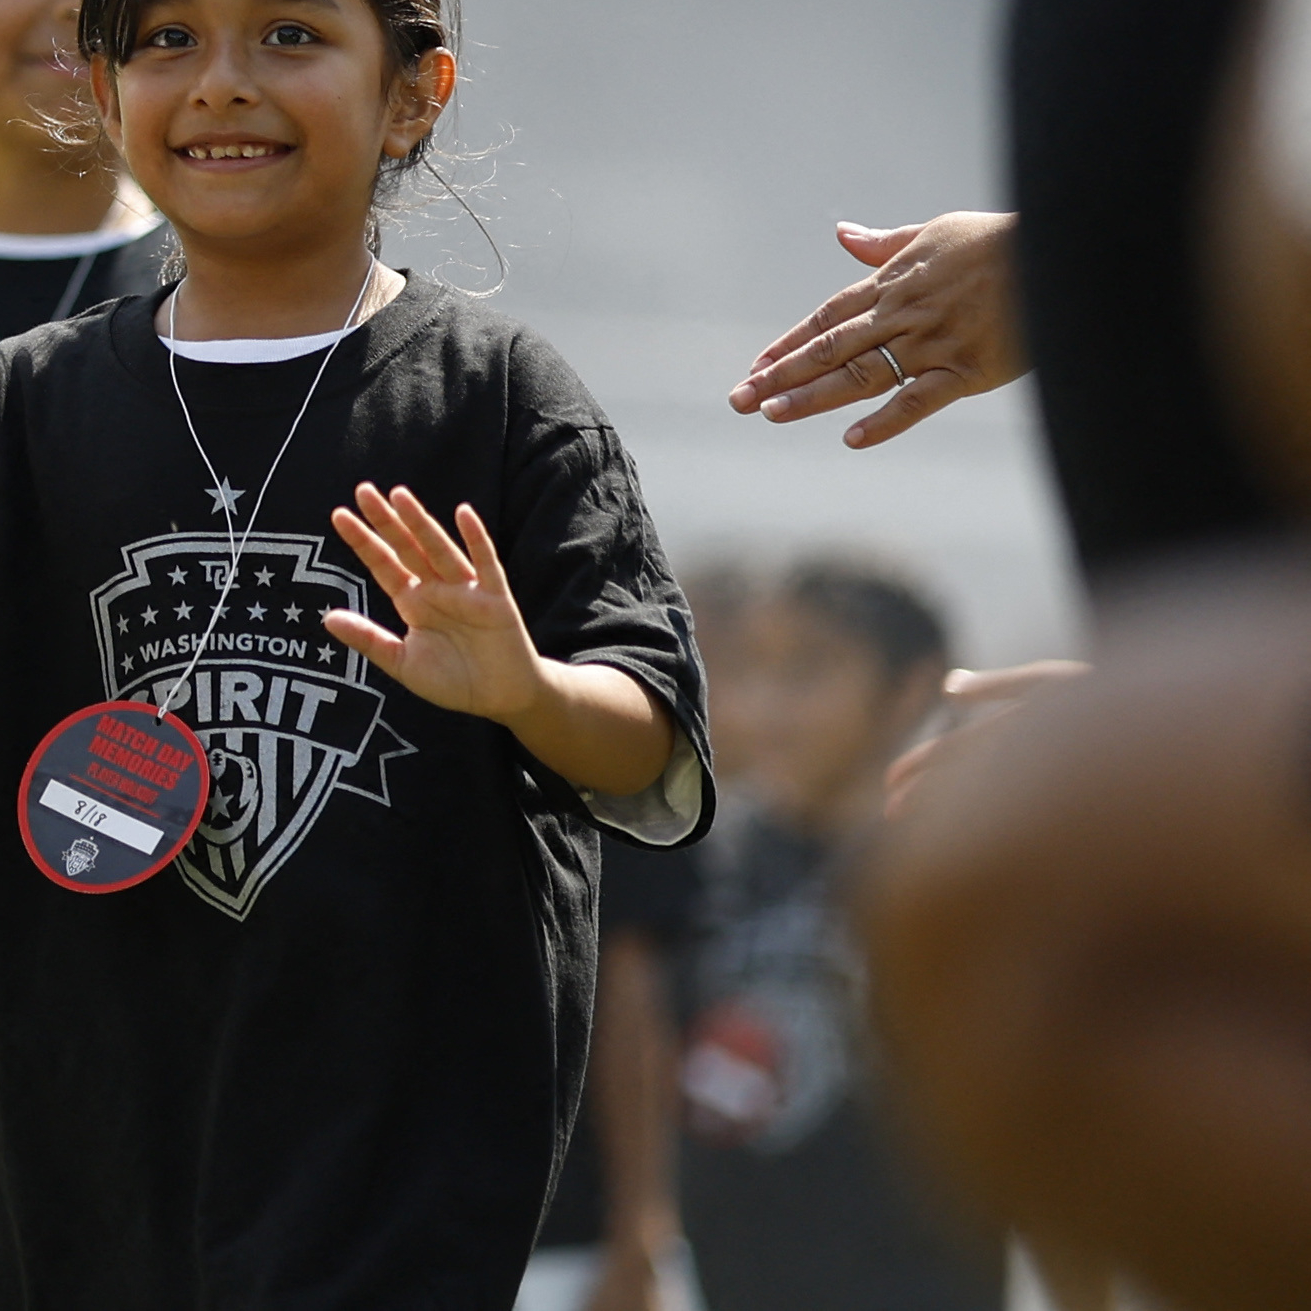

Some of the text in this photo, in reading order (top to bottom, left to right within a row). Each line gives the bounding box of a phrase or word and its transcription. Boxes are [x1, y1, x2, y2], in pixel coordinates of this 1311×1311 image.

[139, 633, 308, 664] WASHINGTON
[128, 670, 339, 733] PIRIT
[88, 735, 181, 790] MEMORIES
[95, 714, 195, 772] MATCH DAY
[75, 800, 107, 827] 8/18
